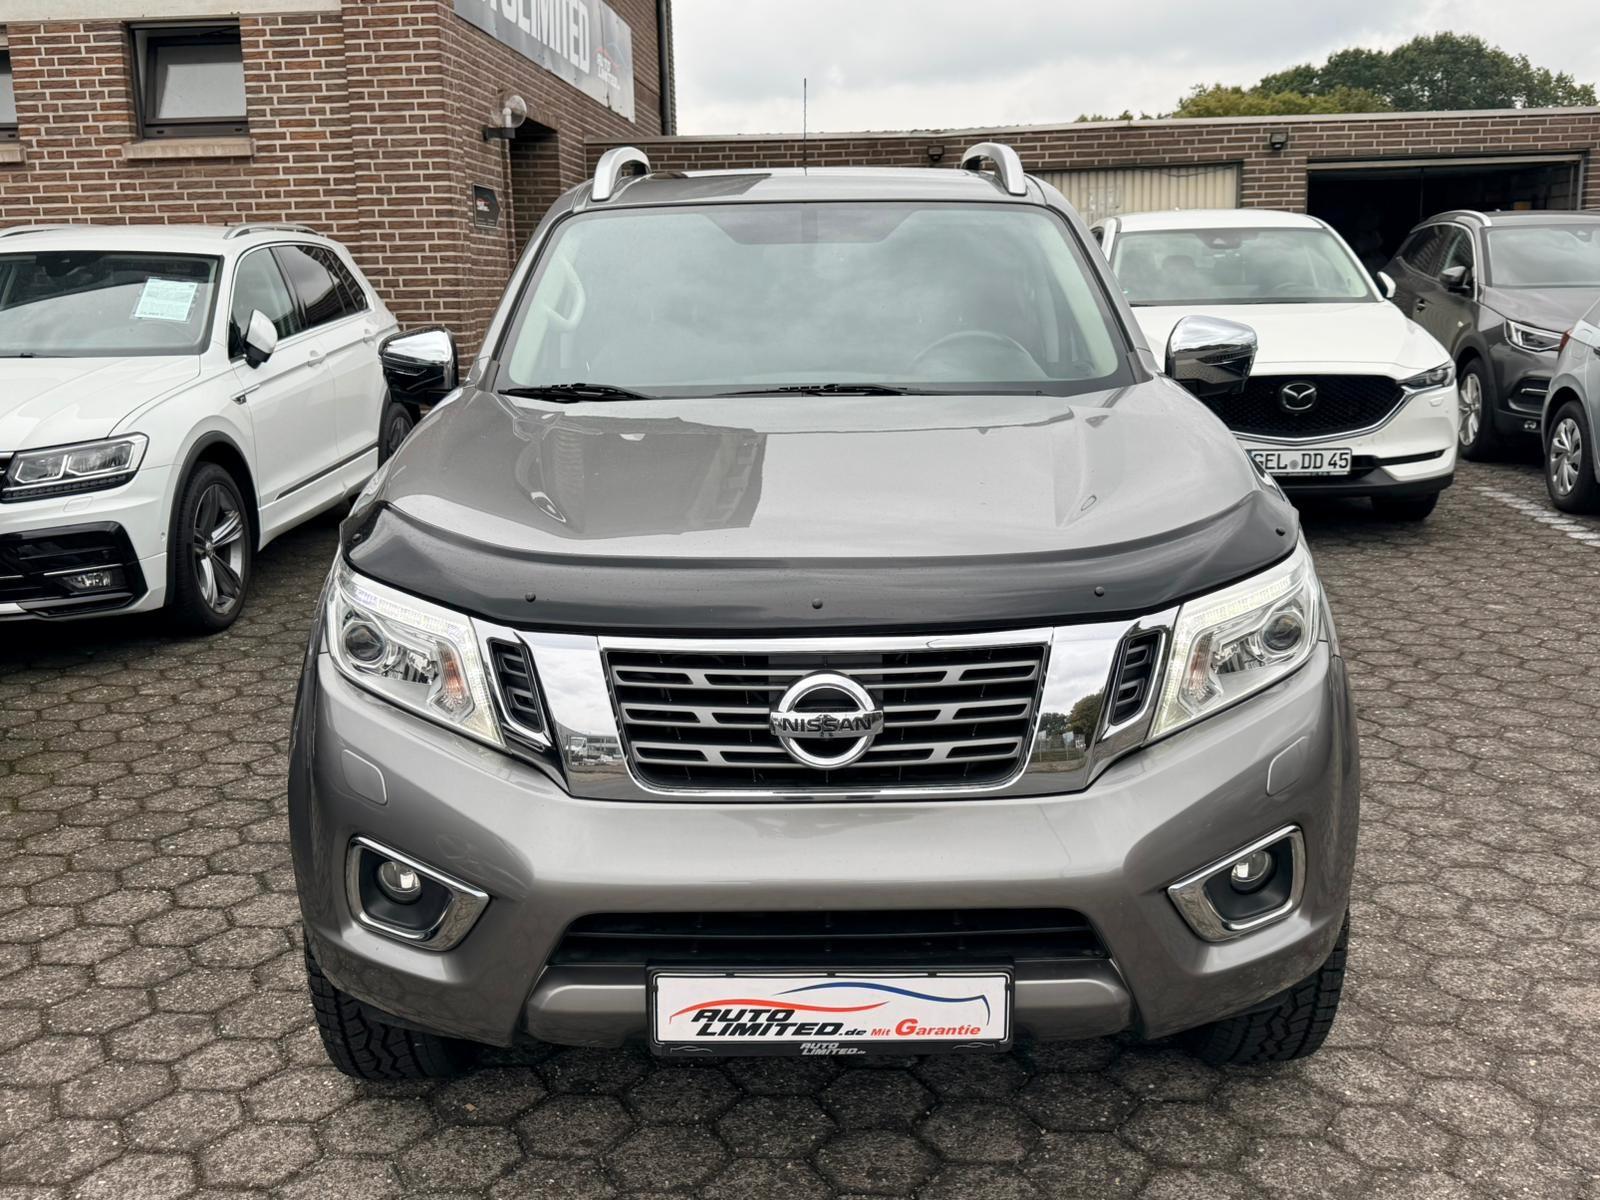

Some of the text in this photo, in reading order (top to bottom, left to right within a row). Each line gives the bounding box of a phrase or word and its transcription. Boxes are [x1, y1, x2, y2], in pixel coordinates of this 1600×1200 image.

[1300, 453, 1324, 470] DD
[1327, 452, 1350, 469] 45
[782, 716, 872, 732] NISSAN
[691, 1009, 796, 1022] AUTO
[696, 1018, 981, 1036] LIMITED.de Mit Garantie
